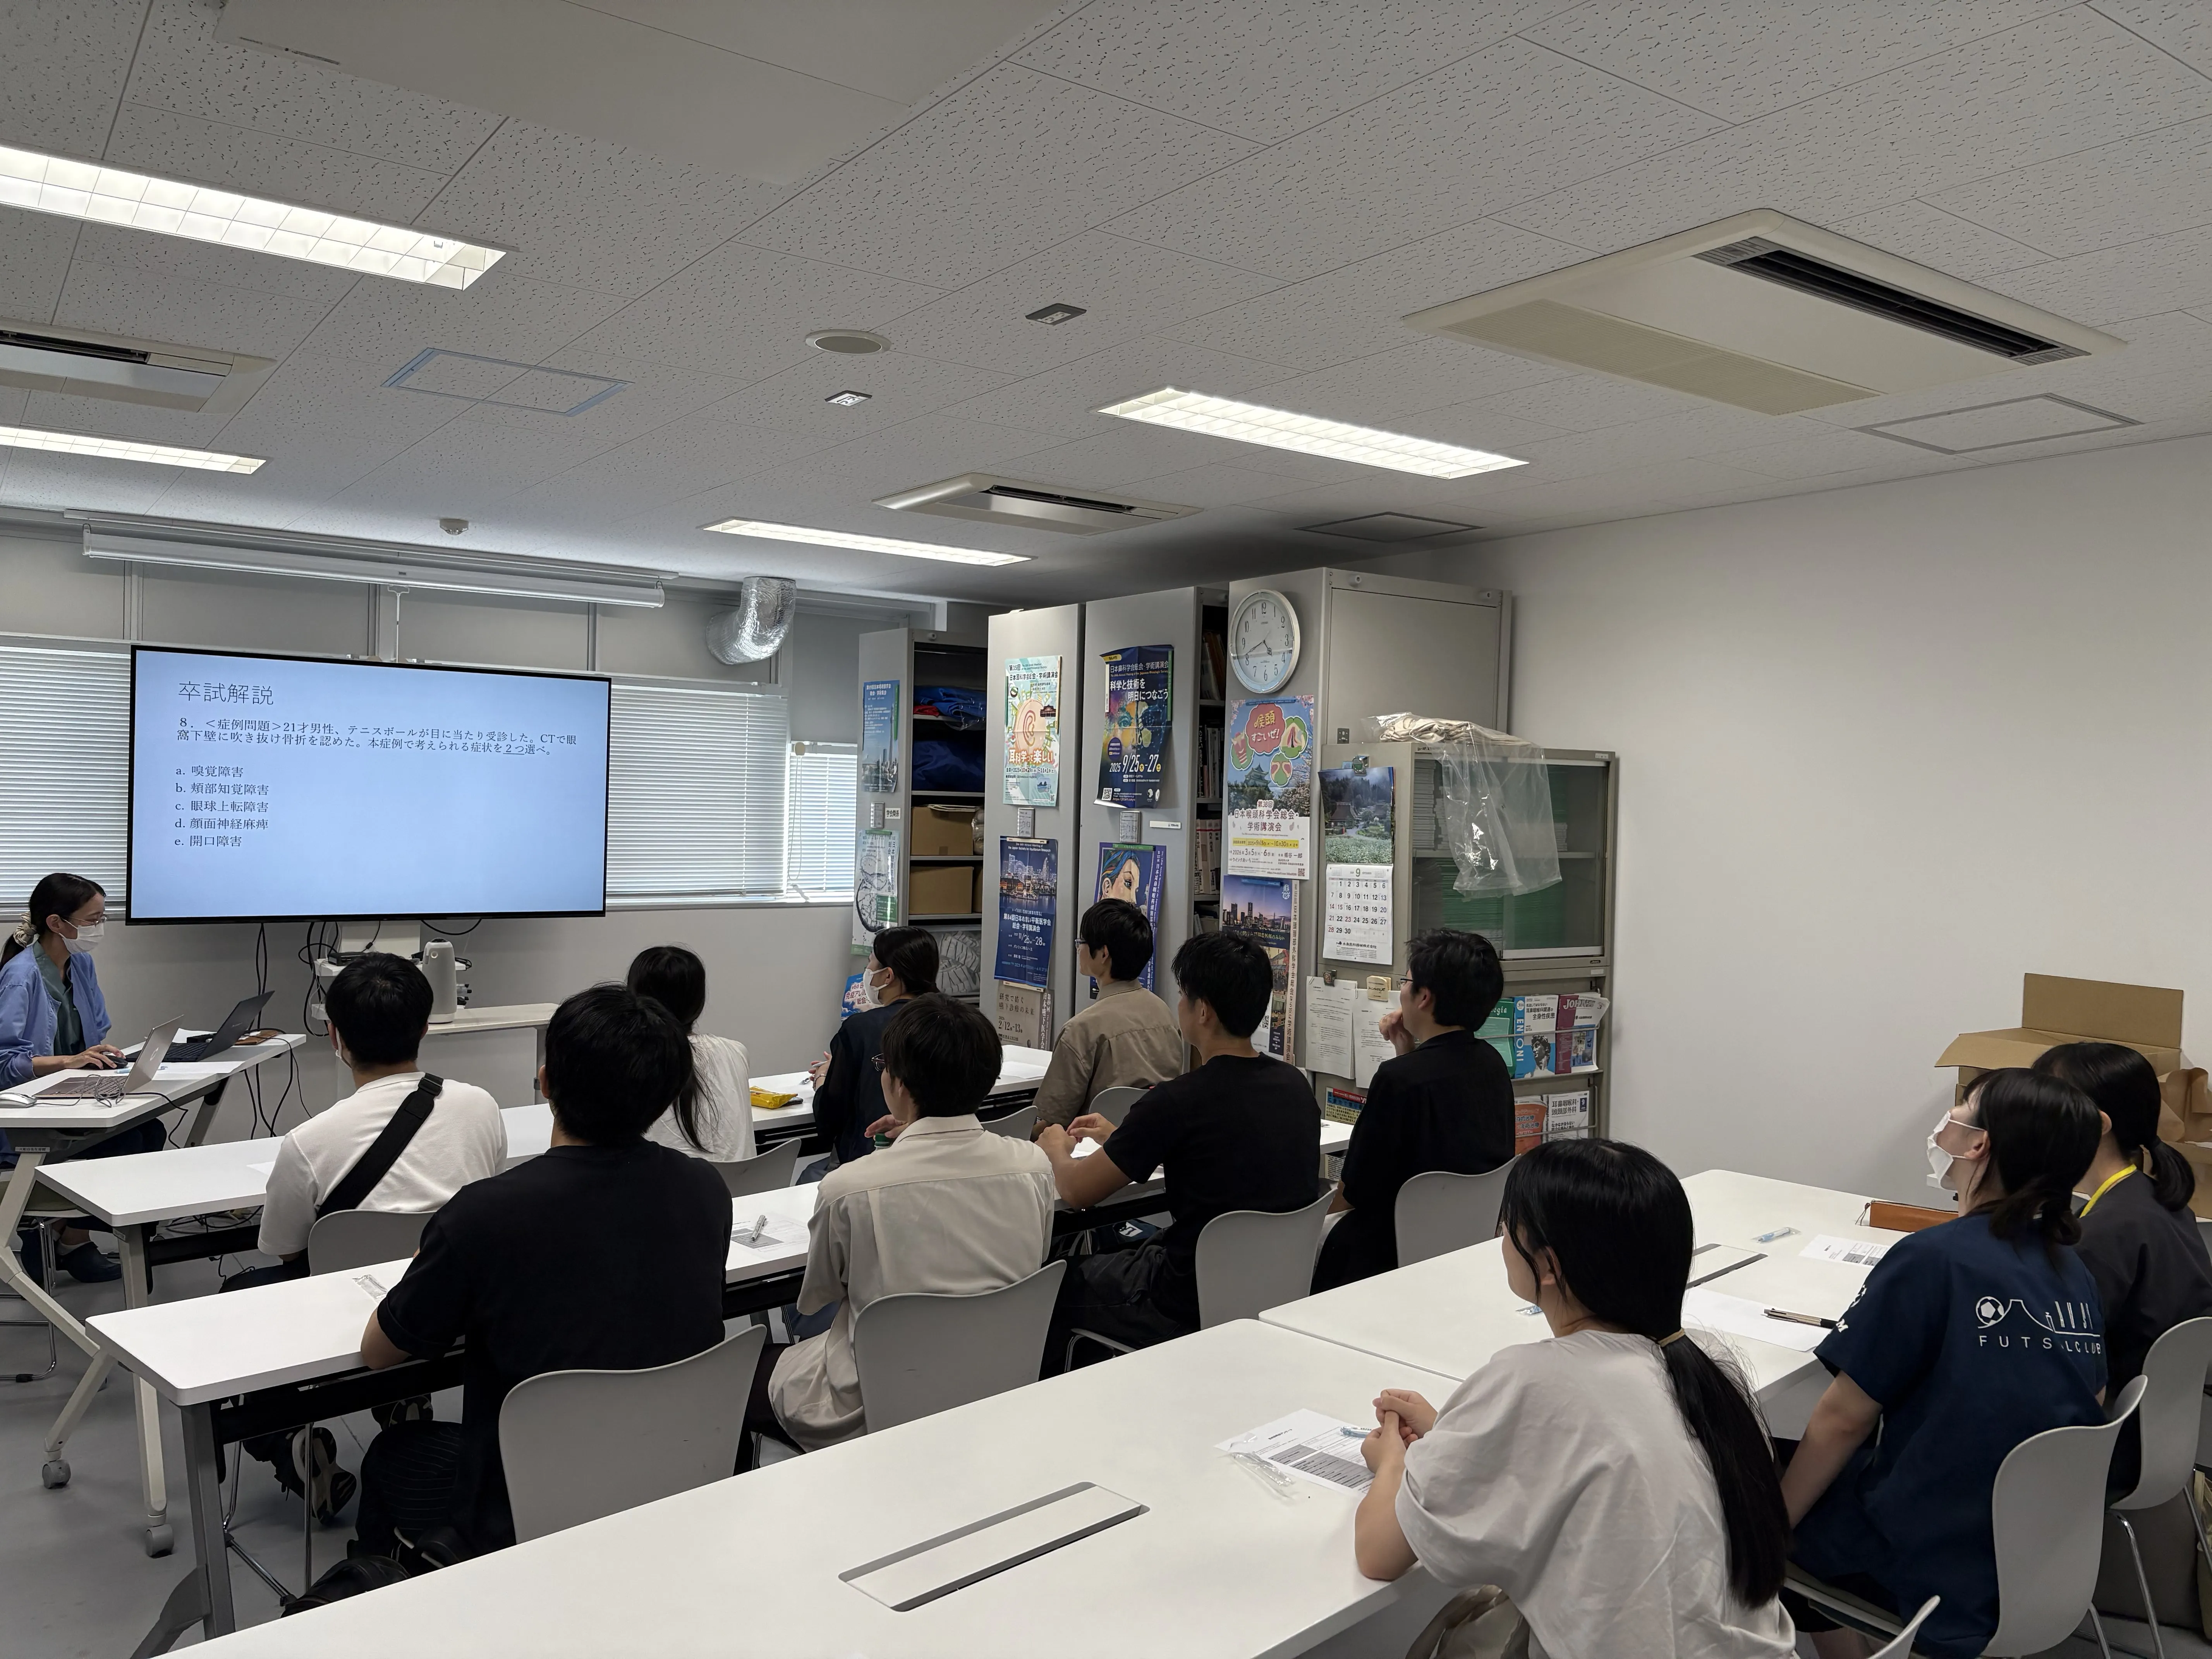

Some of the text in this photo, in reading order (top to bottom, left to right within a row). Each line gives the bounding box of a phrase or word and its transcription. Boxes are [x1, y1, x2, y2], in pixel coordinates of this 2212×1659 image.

[1252, 608, 1256, 620] 11
[1261, 602, 1266, 614] 12
[1274, 606, 1276, 618] 1
[1245, 620, 1249, 633] 10
[1281, 616, 1285, 628] 2
[1242, 637, 1245, 649] 9
[1285, 634, 1289, 646] 3
[1245, 653, 1249, 666] 8
[1281, 652, 1285, 663] 4
[1253, 666, 1257, 677] 7
[1264, 668, 1267, 681] 6
[1274, 664, 1278, 676] 5
[1110, 678, 1146, 691] 科学と技術を
[178, 681, 274, 705] 卒試解説
[1128, 689, 1168, 701] 明日につなごう
[1009, 749, 1053, 764] 耳科学って楽しい
[192, 765, 243, 778] 嗅覚障害
[1109, 763, 1121, 772] 2025
[175, 783, 186, 792] b.
[191, 800, 268, 812] 眼球上転障害
[175, 817, 269, 830] d. 顔面神経麻痺
[1247, 821, 1282, 831] 学術講演会
[190, 835, 242, 847] 開口障害
[1355, 868, 1360, 877] 9
[1563, 999, 1595, 1010] JOHNS
[1516, 1018, 1525, 1061] ENONI
[1979, 1335, 2101, 1354] FUTSLCLUB
